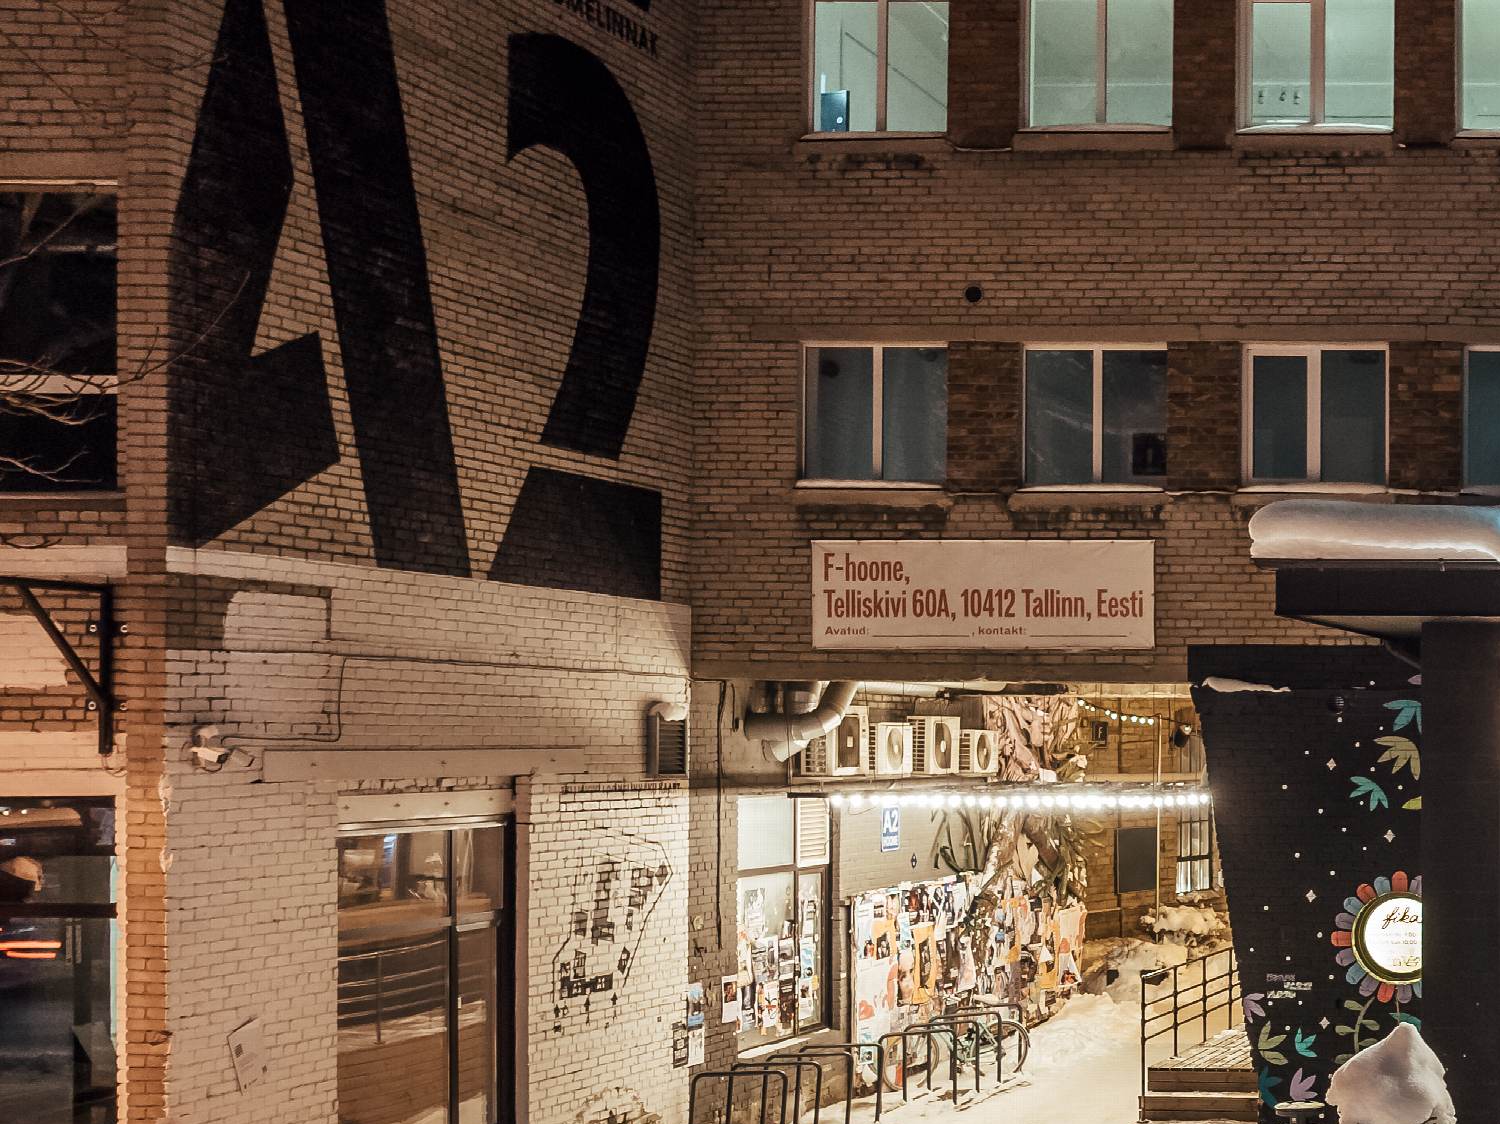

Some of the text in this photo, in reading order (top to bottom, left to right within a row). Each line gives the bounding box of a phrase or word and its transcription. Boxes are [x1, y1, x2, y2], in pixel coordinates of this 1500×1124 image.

[823, 552, 911, 585] F-hoone,
[823, 589, 1144, 621] Telliskivi 60A, 10412 Tallinn, Eesti
[824, 626, 870, 636] Avatud:
[1381, 906, 1423, 930] fika
